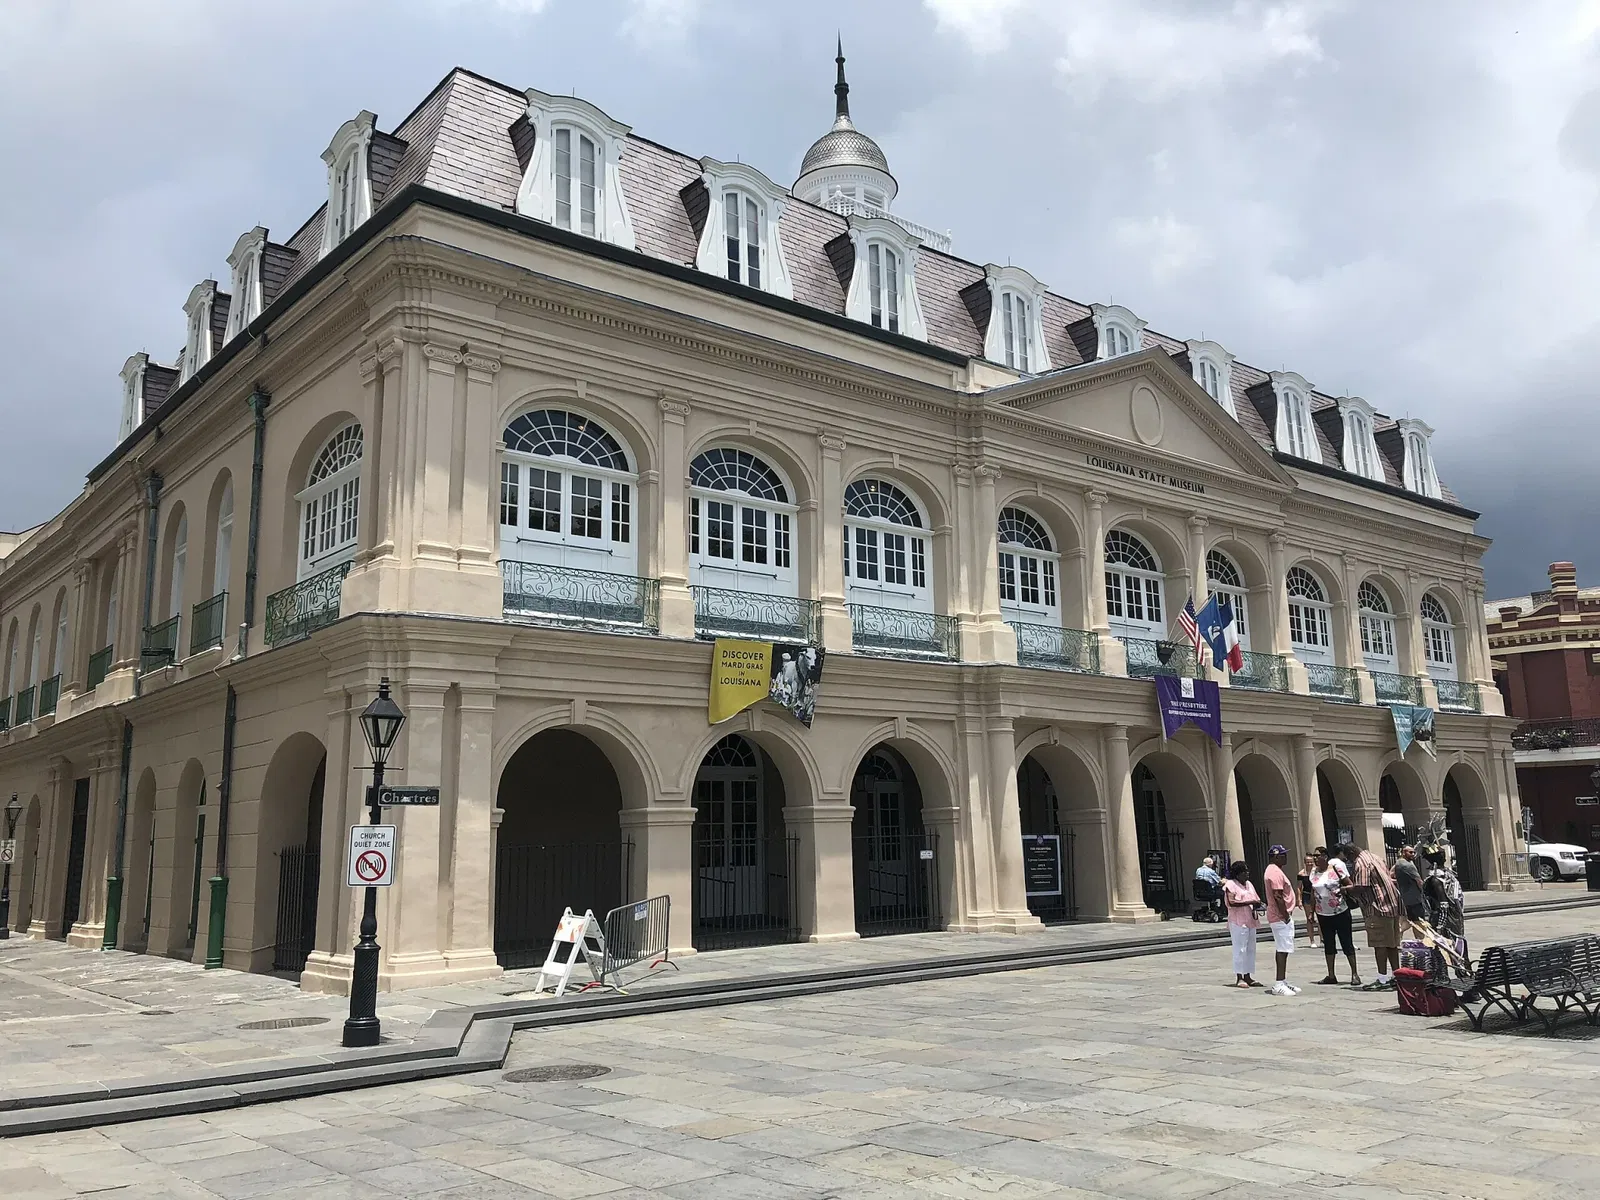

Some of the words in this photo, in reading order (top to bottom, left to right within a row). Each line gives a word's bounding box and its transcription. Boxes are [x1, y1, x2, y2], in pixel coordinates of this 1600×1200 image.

[1086, 455, 1136, 477] LOUISIANA
[1138, 469, 1167, 485] STATE
[1169, 477, 1205, 494] MUSEUM
[722, 650, 764, 661] DISCOVER
[721, 661, 745, 669] MARDI
[746, 662, 764, 670] GRAS
[720, 677, 762, 687] LOUISIANA
[360, 832, 386, 840] CHURCH
